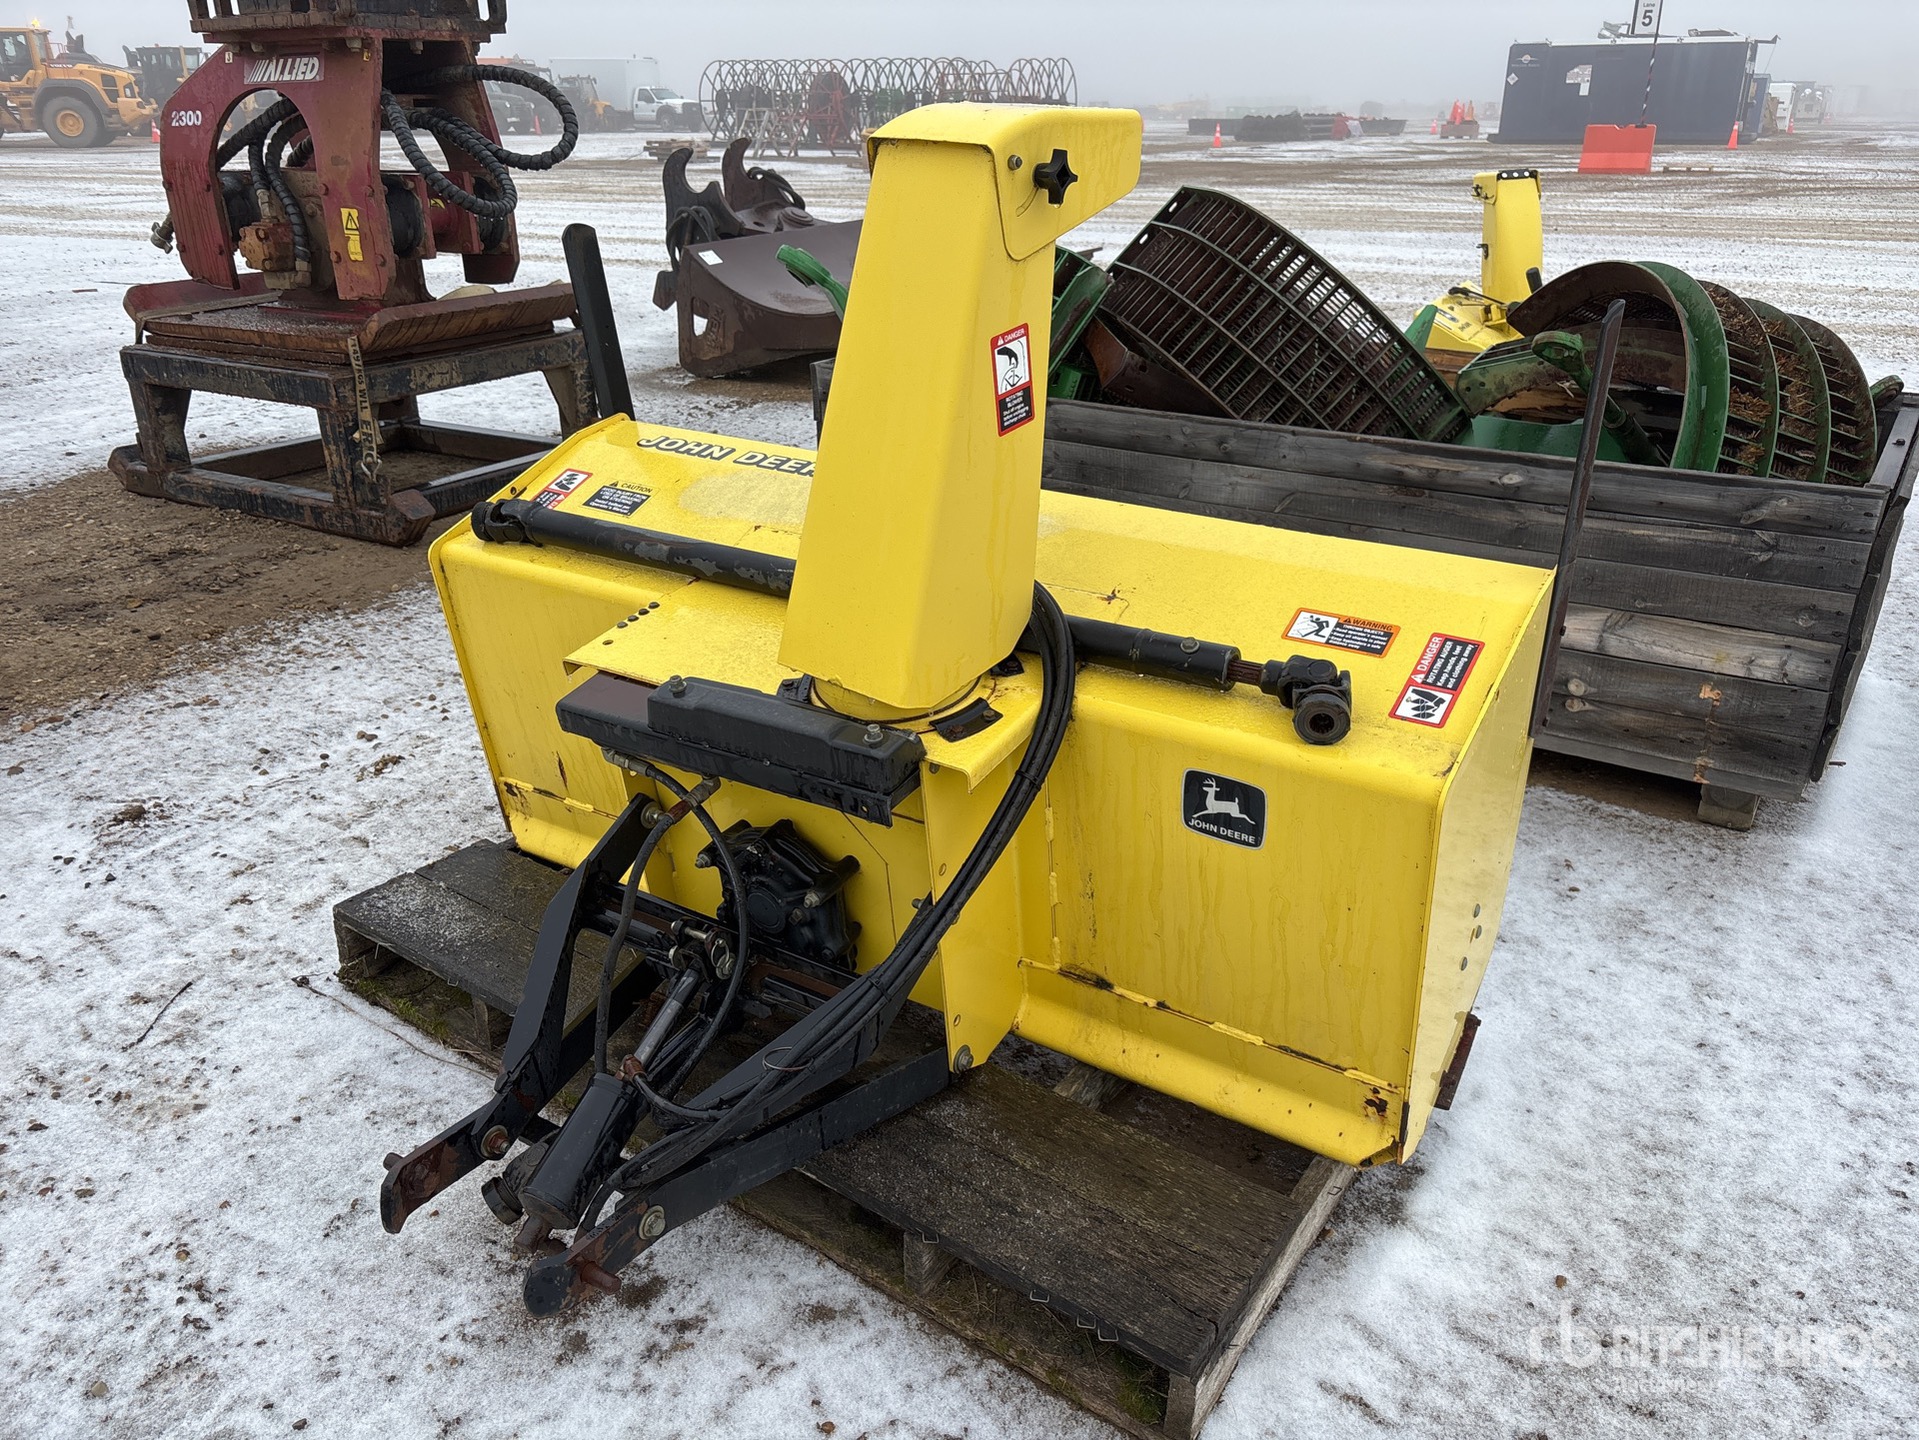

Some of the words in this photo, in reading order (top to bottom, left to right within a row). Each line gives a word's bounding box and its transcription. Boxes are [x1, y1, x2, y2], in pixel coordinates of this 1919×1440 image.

[1641, 9, 1653, 27] 5
[264, 56, 320, 82] ALLIED
[171, 110, 202, 127] 2300
[1004, 328, 1024, 342] DANGER
[358, 388, 369, 413] WLL
[637, 436, 736, 461] JOHN
[621, 482, 653, 494] CAUTION
[1352, 618, 1394, 632] WARNING
[1417, 636, 1443, 672] DANGER
[1426, 658, 1444, 683] ROTATING
[1440, 641, 1454, 658] AUGER
[1436, 672, 1449, 686] Keep
[1452, 645, 1462, 655] feet
[1447, 677, 1456, 688] and
[1452, 657, 1468, 678] clothing
[1463, 644, 1475, 657] away
[1188, 818, 1218, 833] JOHN
[1220, 827, 1256, 844] DEERE
